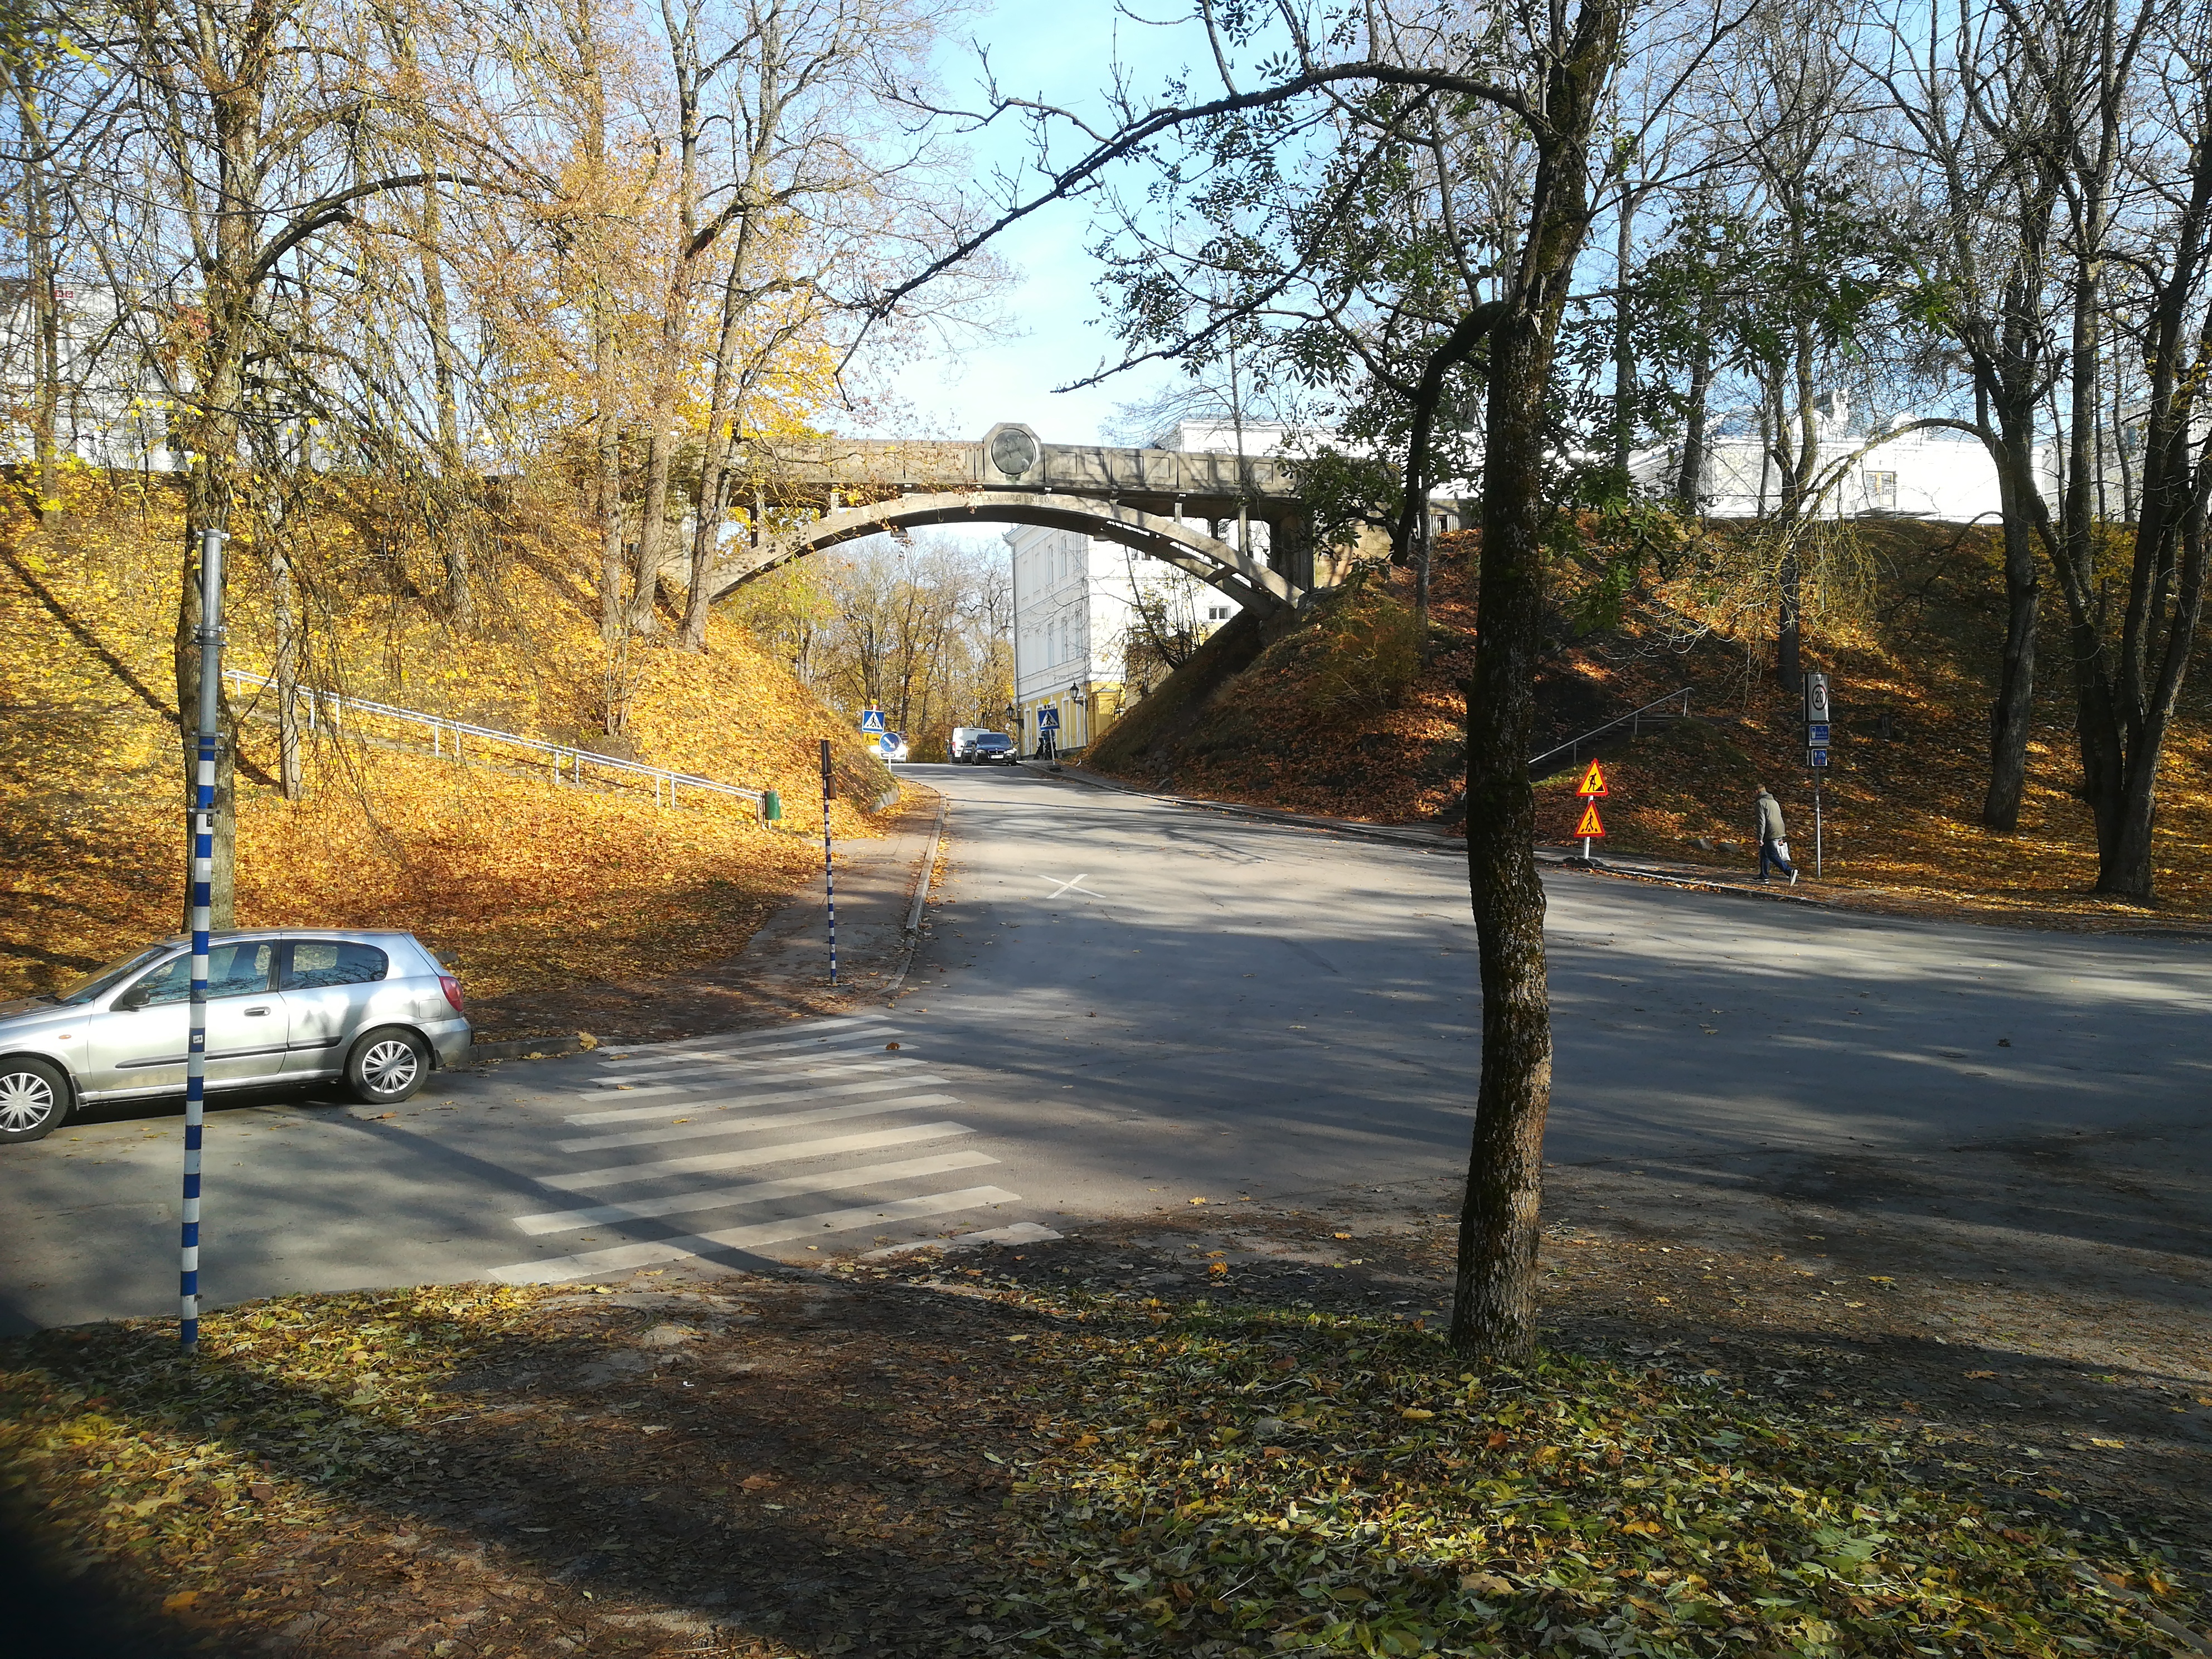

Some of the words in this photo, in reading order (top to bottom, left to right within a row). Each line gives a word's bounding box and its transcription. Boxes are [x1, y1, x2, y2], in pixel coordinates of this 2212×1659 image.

[971, 494, 1021, 502] ALEXANDRO
[1023, 494, 1050, 503] PRIMO
[1815, 691, 1823, 703] 20
